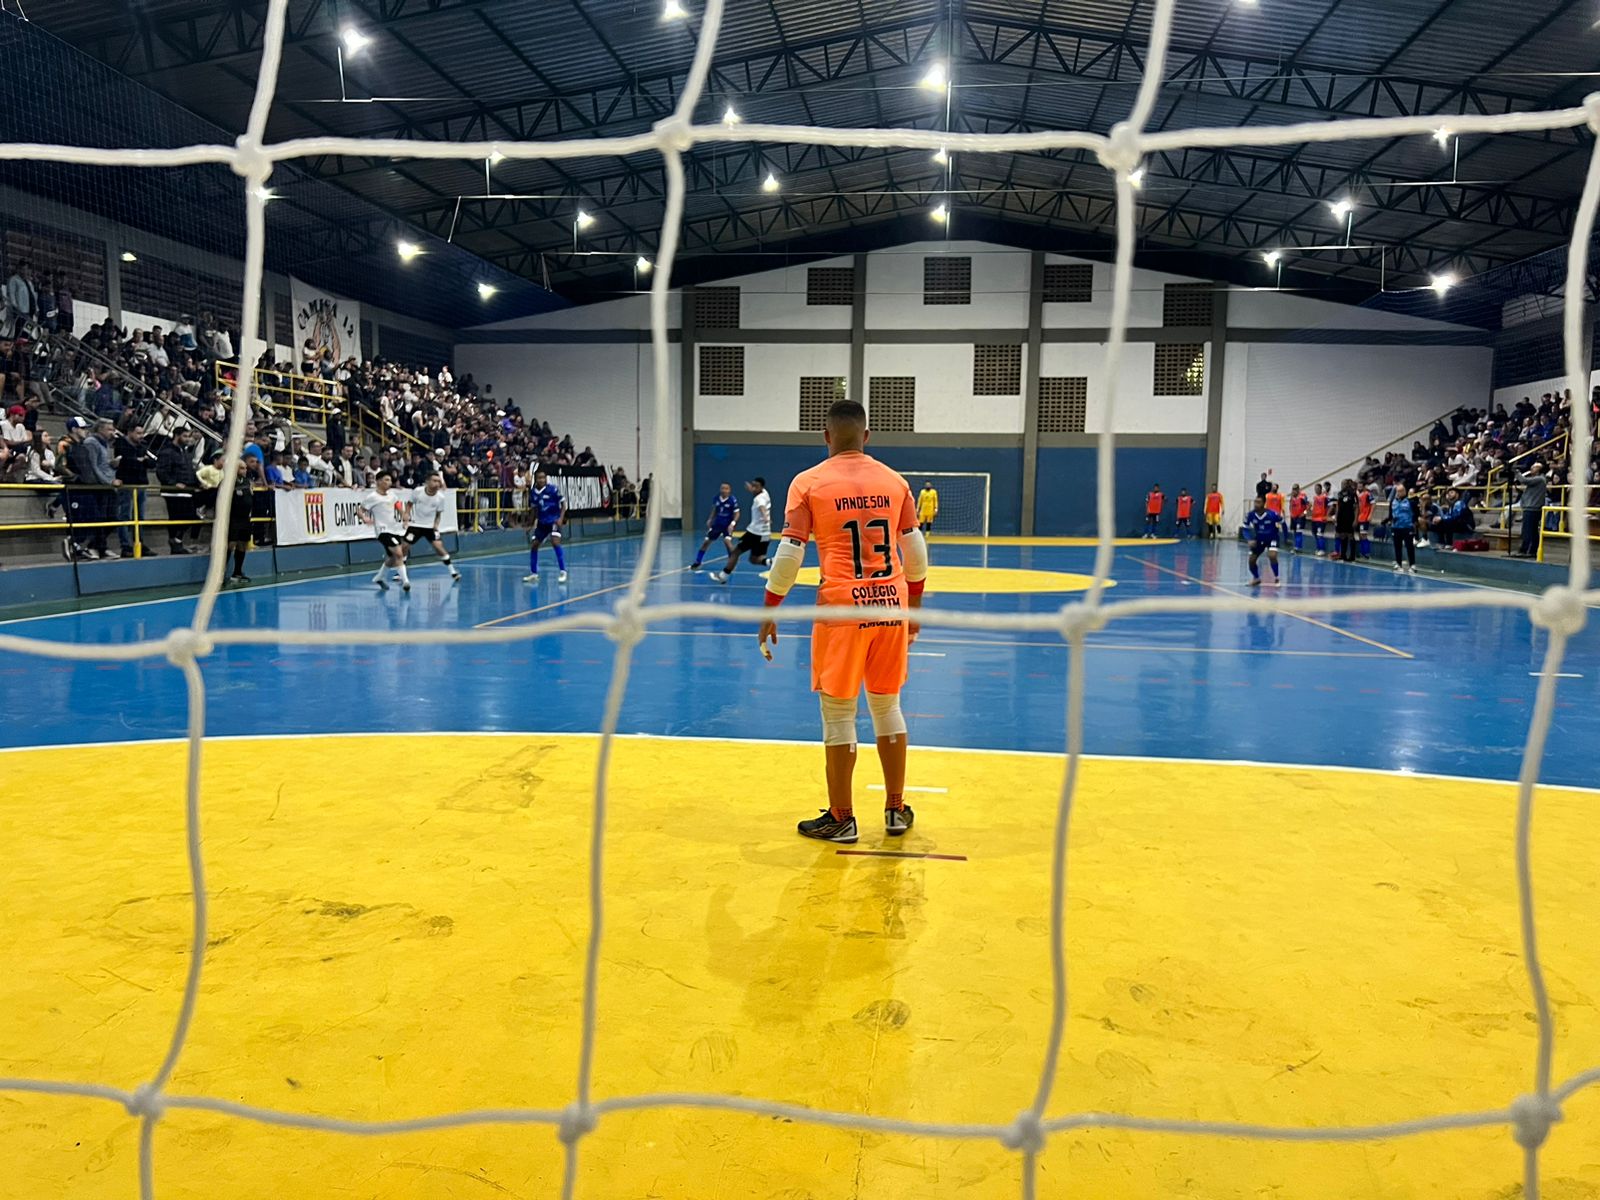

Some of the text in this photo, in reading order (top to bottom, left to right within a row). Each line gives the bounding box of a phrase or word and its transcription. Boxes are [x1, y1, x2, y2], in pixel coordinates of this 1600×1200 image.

[834, 495, 890, 511] VANDESON
[842, 518, 893, 580] 13
[851, 583, 897, 600] COLÉGIO
